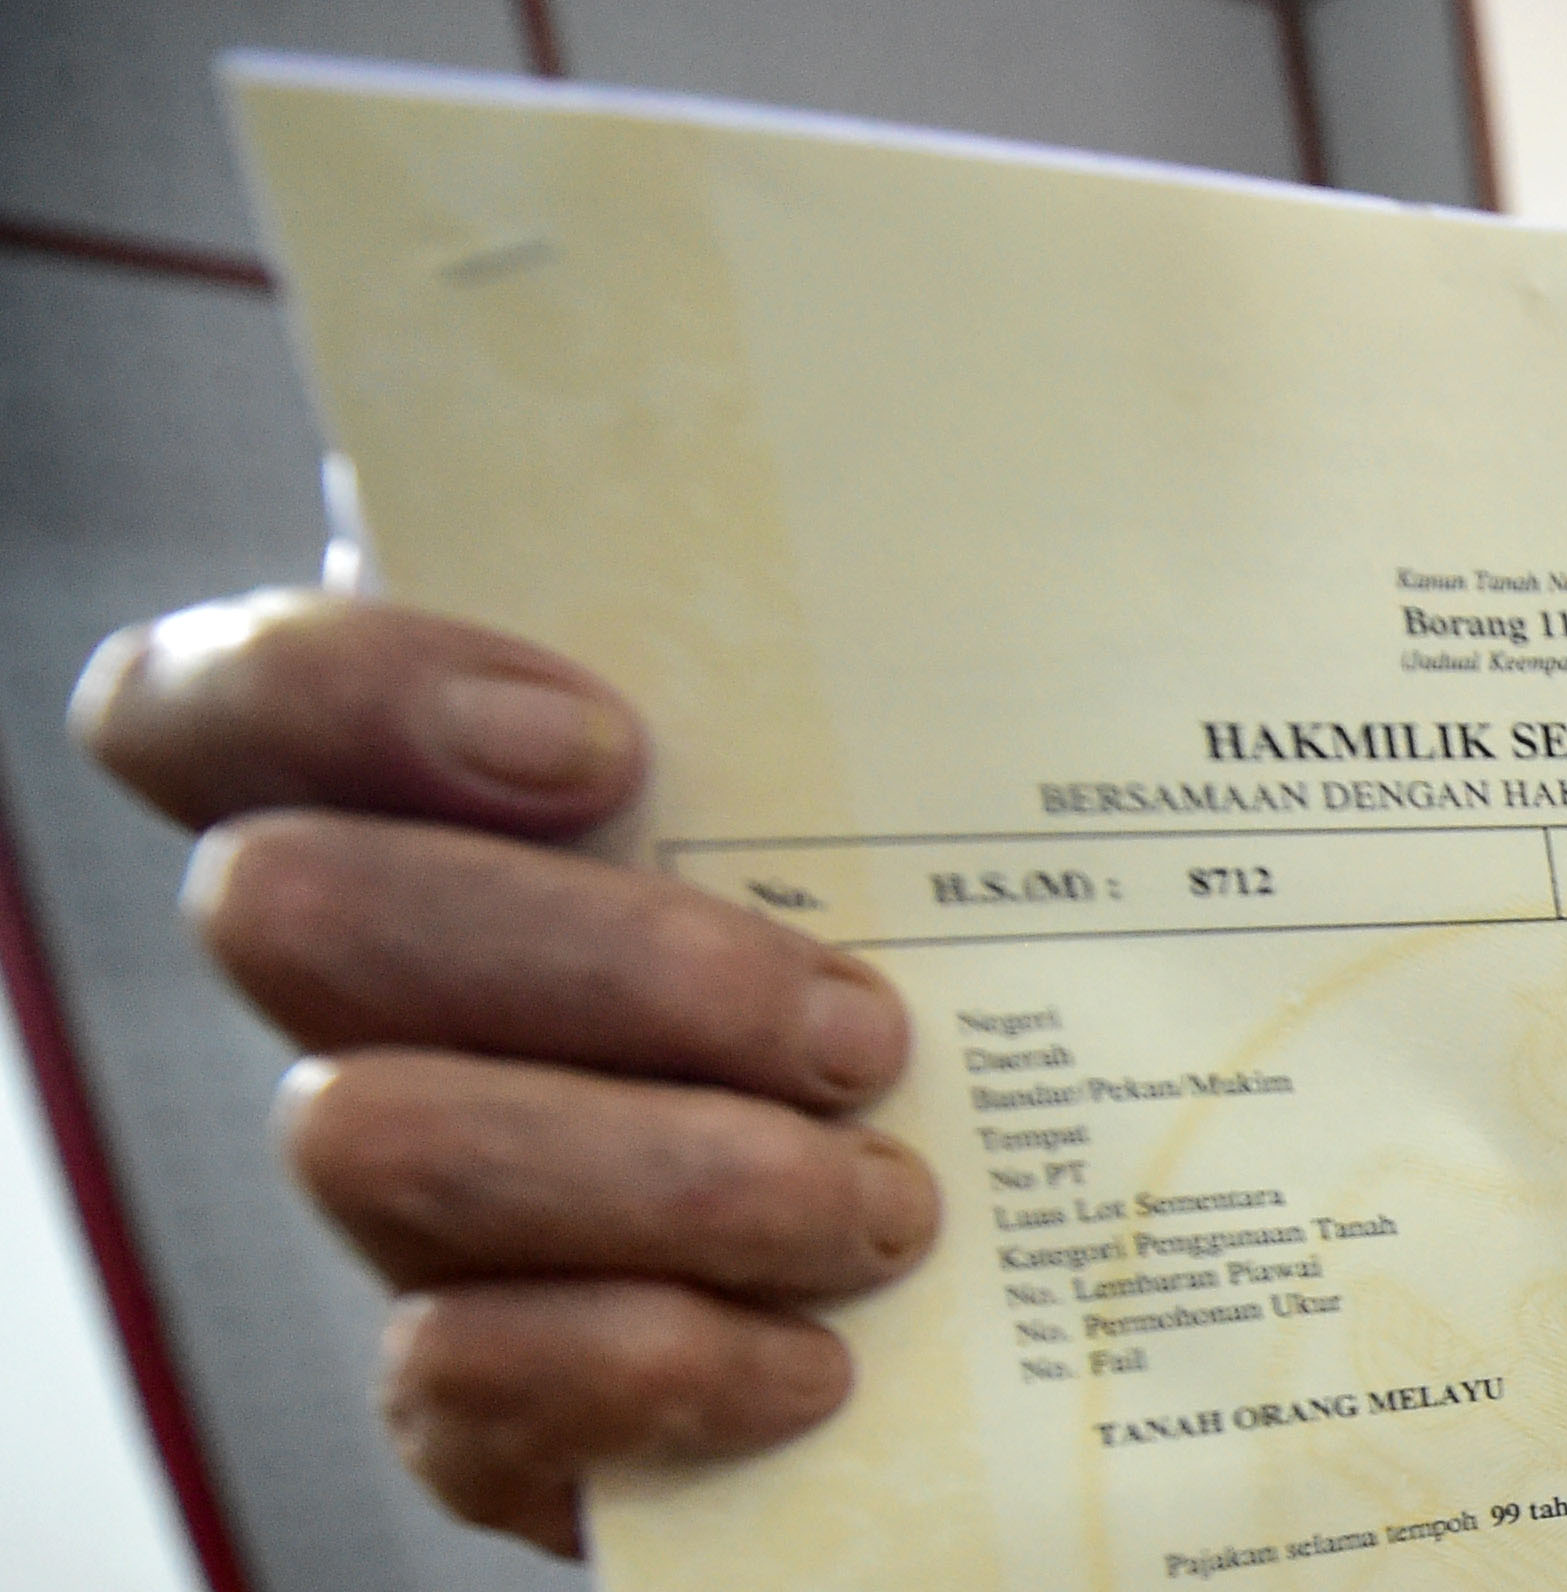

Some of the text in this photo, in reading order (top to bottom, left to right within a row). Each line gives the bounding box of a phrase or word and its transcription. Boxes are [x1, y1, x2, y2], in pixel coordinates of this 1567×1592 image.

[1397, 567, 1465, 592] Kanun
[1474, 570, 1540, 592] Tanah
[1402, 605, 1528, 644] Borang
[1202, 720, 1496, 762] HAKMILIK
[1039, 780, 1308, 816] BERSAMAAN
[1322, 779, 1491, 812] DENGAN
[1186, 864, 1276, 899] 8712
[976, 1122, 1091, 1155] Tempat
[1045, 1160, 1088, 1188] PT
[1075, 1198, 1127, 1225] Lot
[1133, 1185, 1288, 1218] Sementara
[998, 1213, 1399, 1272] Kategori Penggunaan Tanah
[1072, 1265, 1221, 1303] Lembaran
[1227, 1256, 1324, 1287] Piawai
[1083, 1298, 1265, 1340] Permohonan
[1270, 1290, 1344, 1319] Ukur
[1087, 1347, 1149, 1376] Fail
[1093, 1376, 1507, 1449] TANAH ORANG MELAYU
[1163, 1543, 1281, 1582] Pajakan
[1284, 1526, 1378, 1562] selama
[1386, 1511, 1480, 1545] tempoh
[1490, 1502, 1521, 1529] 99
